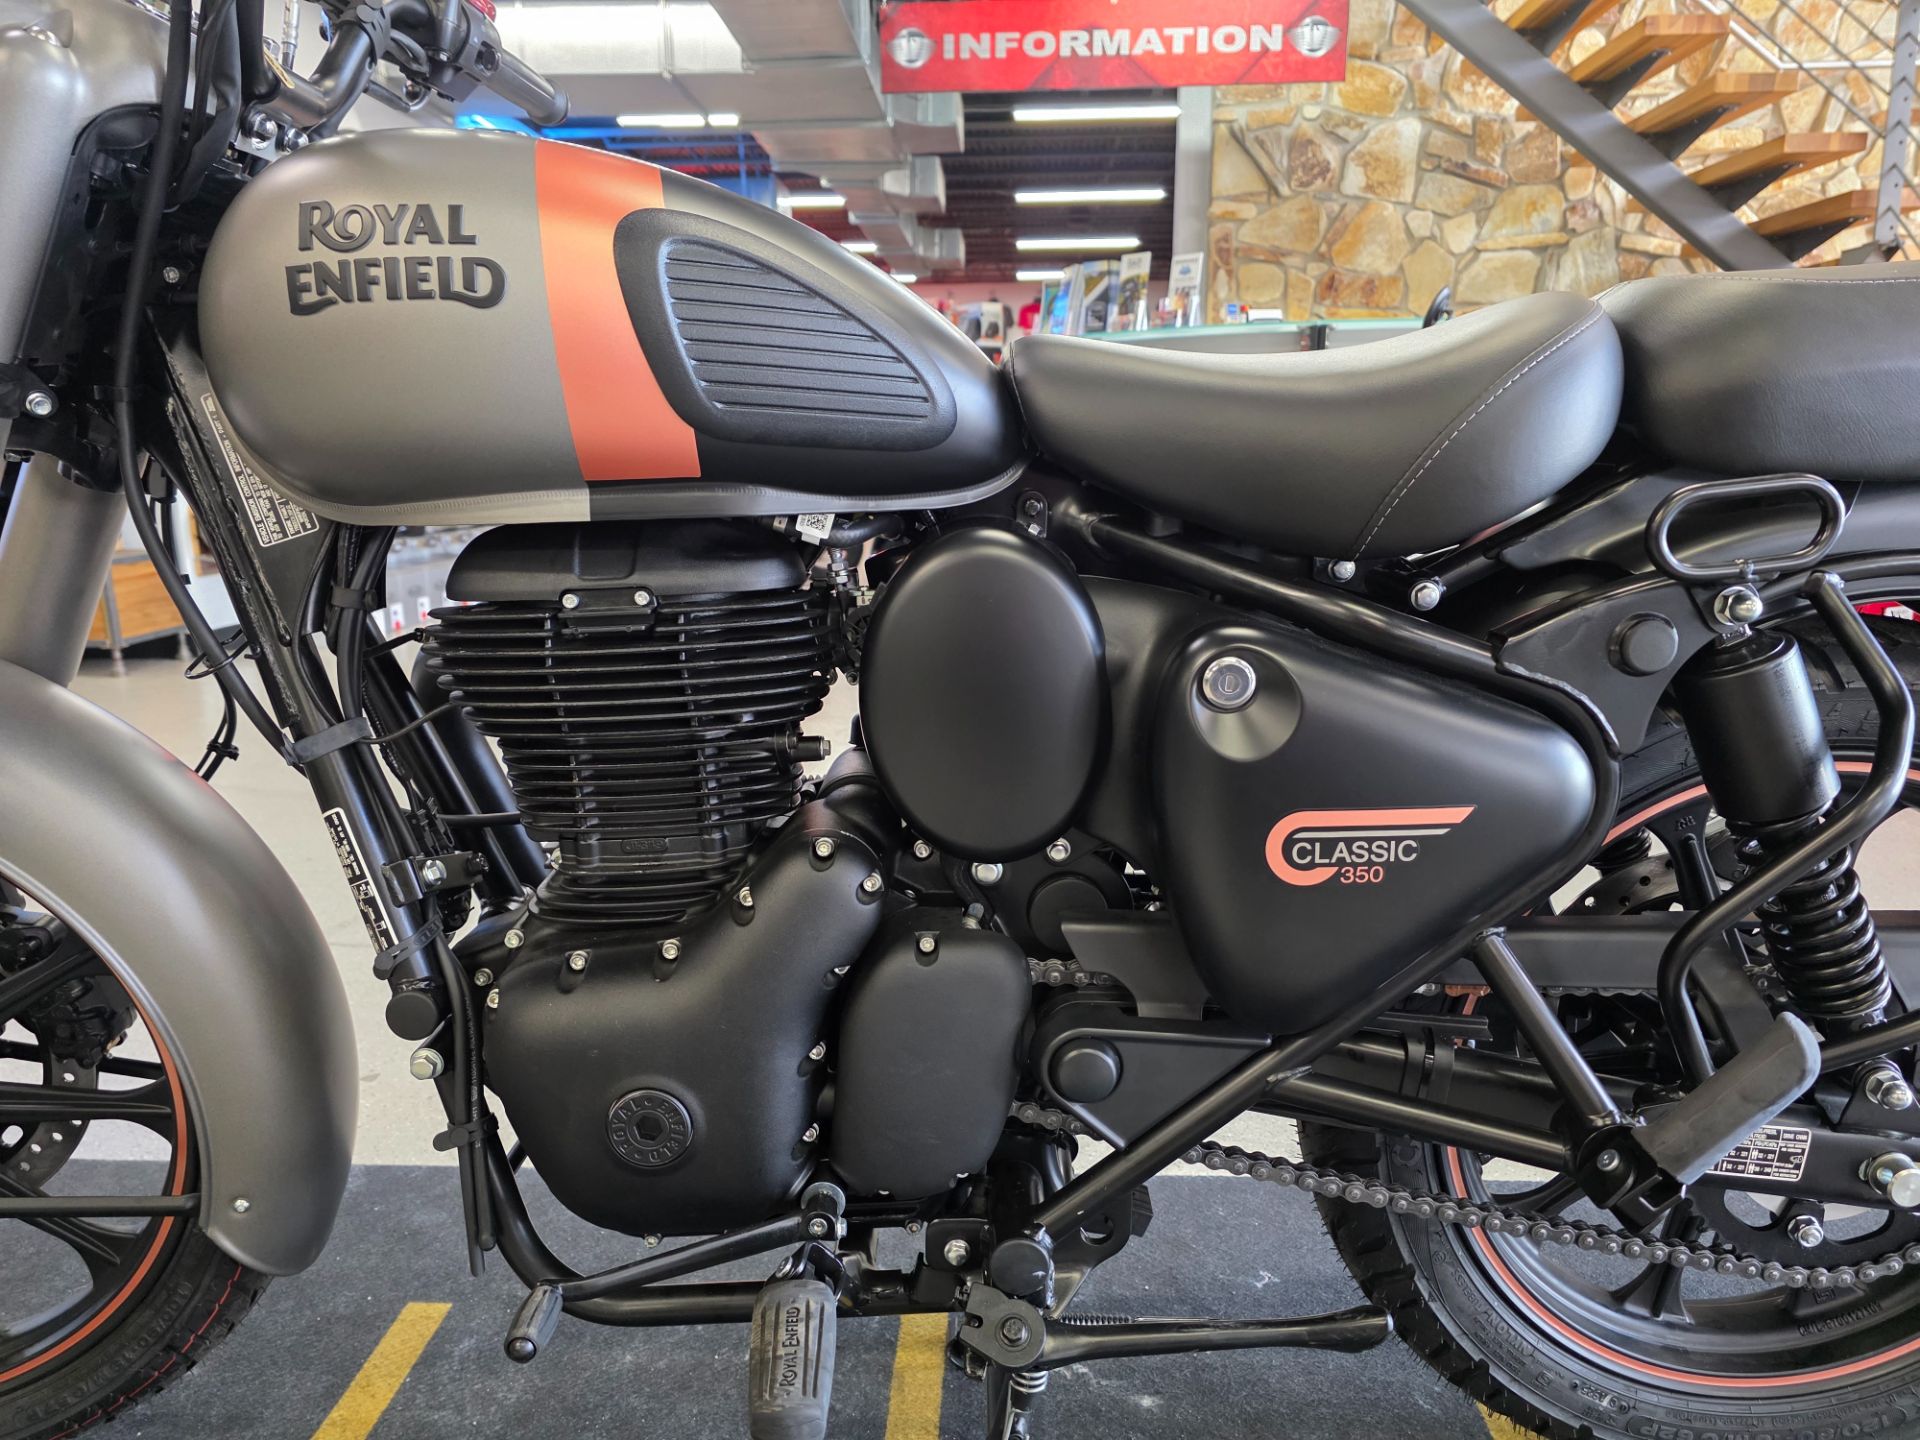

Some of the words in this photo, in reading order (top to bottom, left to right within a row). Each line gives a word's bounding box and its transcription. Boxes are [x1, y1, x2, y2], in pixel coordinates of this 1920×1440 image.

[943, 24, 1283, 60] INFORMATION
[298, 199, 478, 252] ROYAL
[285, 256, 507, 315] ENFIELD
[1292, 840, 1418, 863] CLASSIC
[1340, 865, 1384, 884] 350
[782, 1306, 801, 1348] ENFIELD
[779, 1350, 798, 1387] ROYAL
